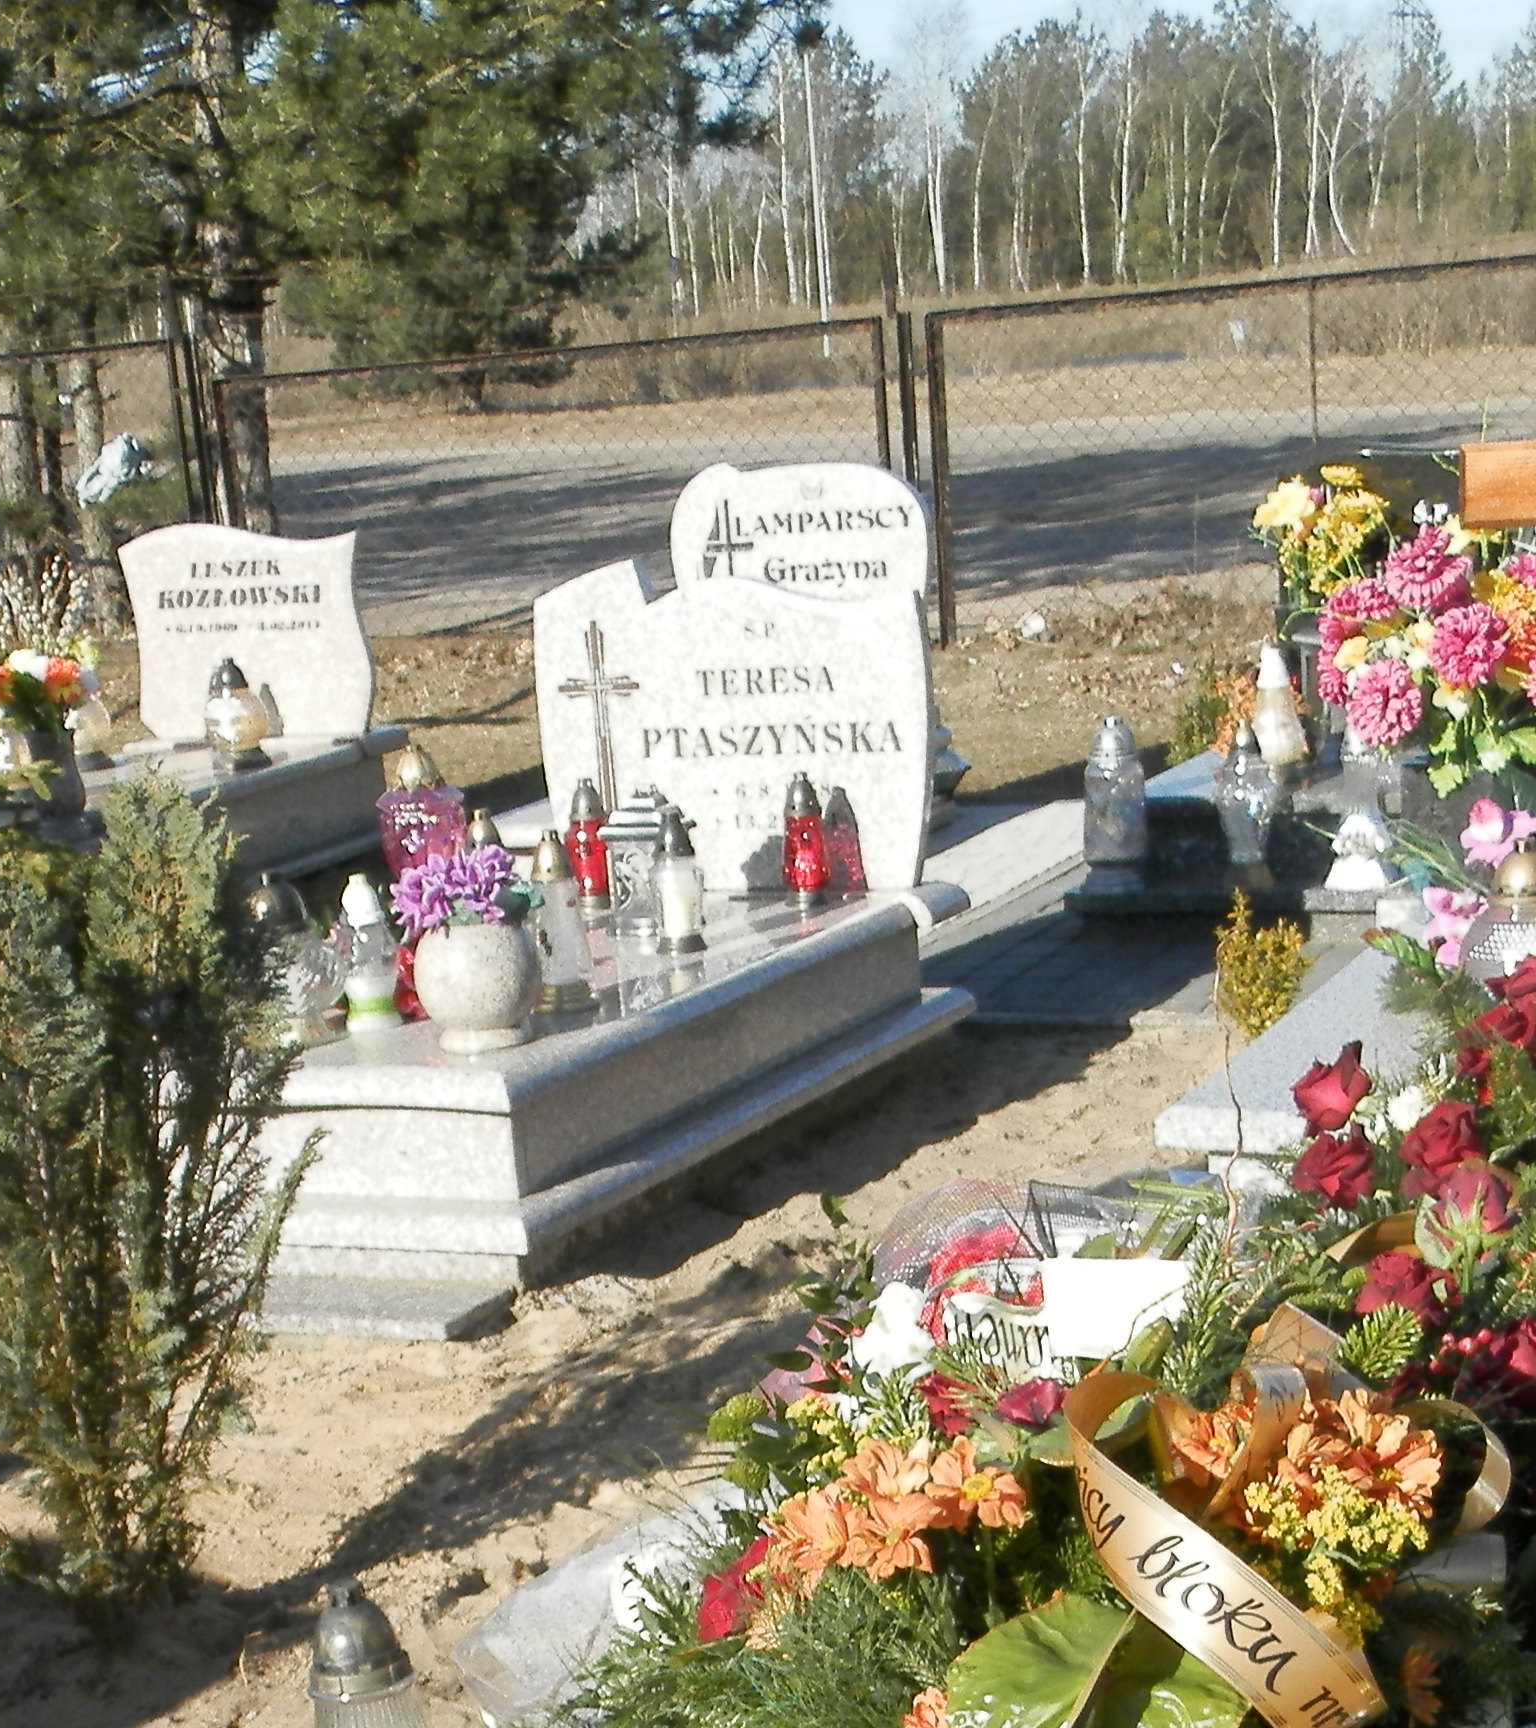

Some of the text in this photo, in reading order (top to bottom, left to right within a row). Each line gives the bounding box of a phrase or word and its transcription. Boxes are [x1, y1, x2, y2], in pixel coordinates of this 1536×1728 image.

[735, 504, 913, 537] LAMPARSCY
[190, 559, 281, 579] LESZEK
[763, 557, 888, 588] Grażyna
[158, 584, 321, 609] KOZŁOWSKI
[695, 665, 835, 696] TERESA
[642, 714, 904, 758] PTASZYŃSKA
